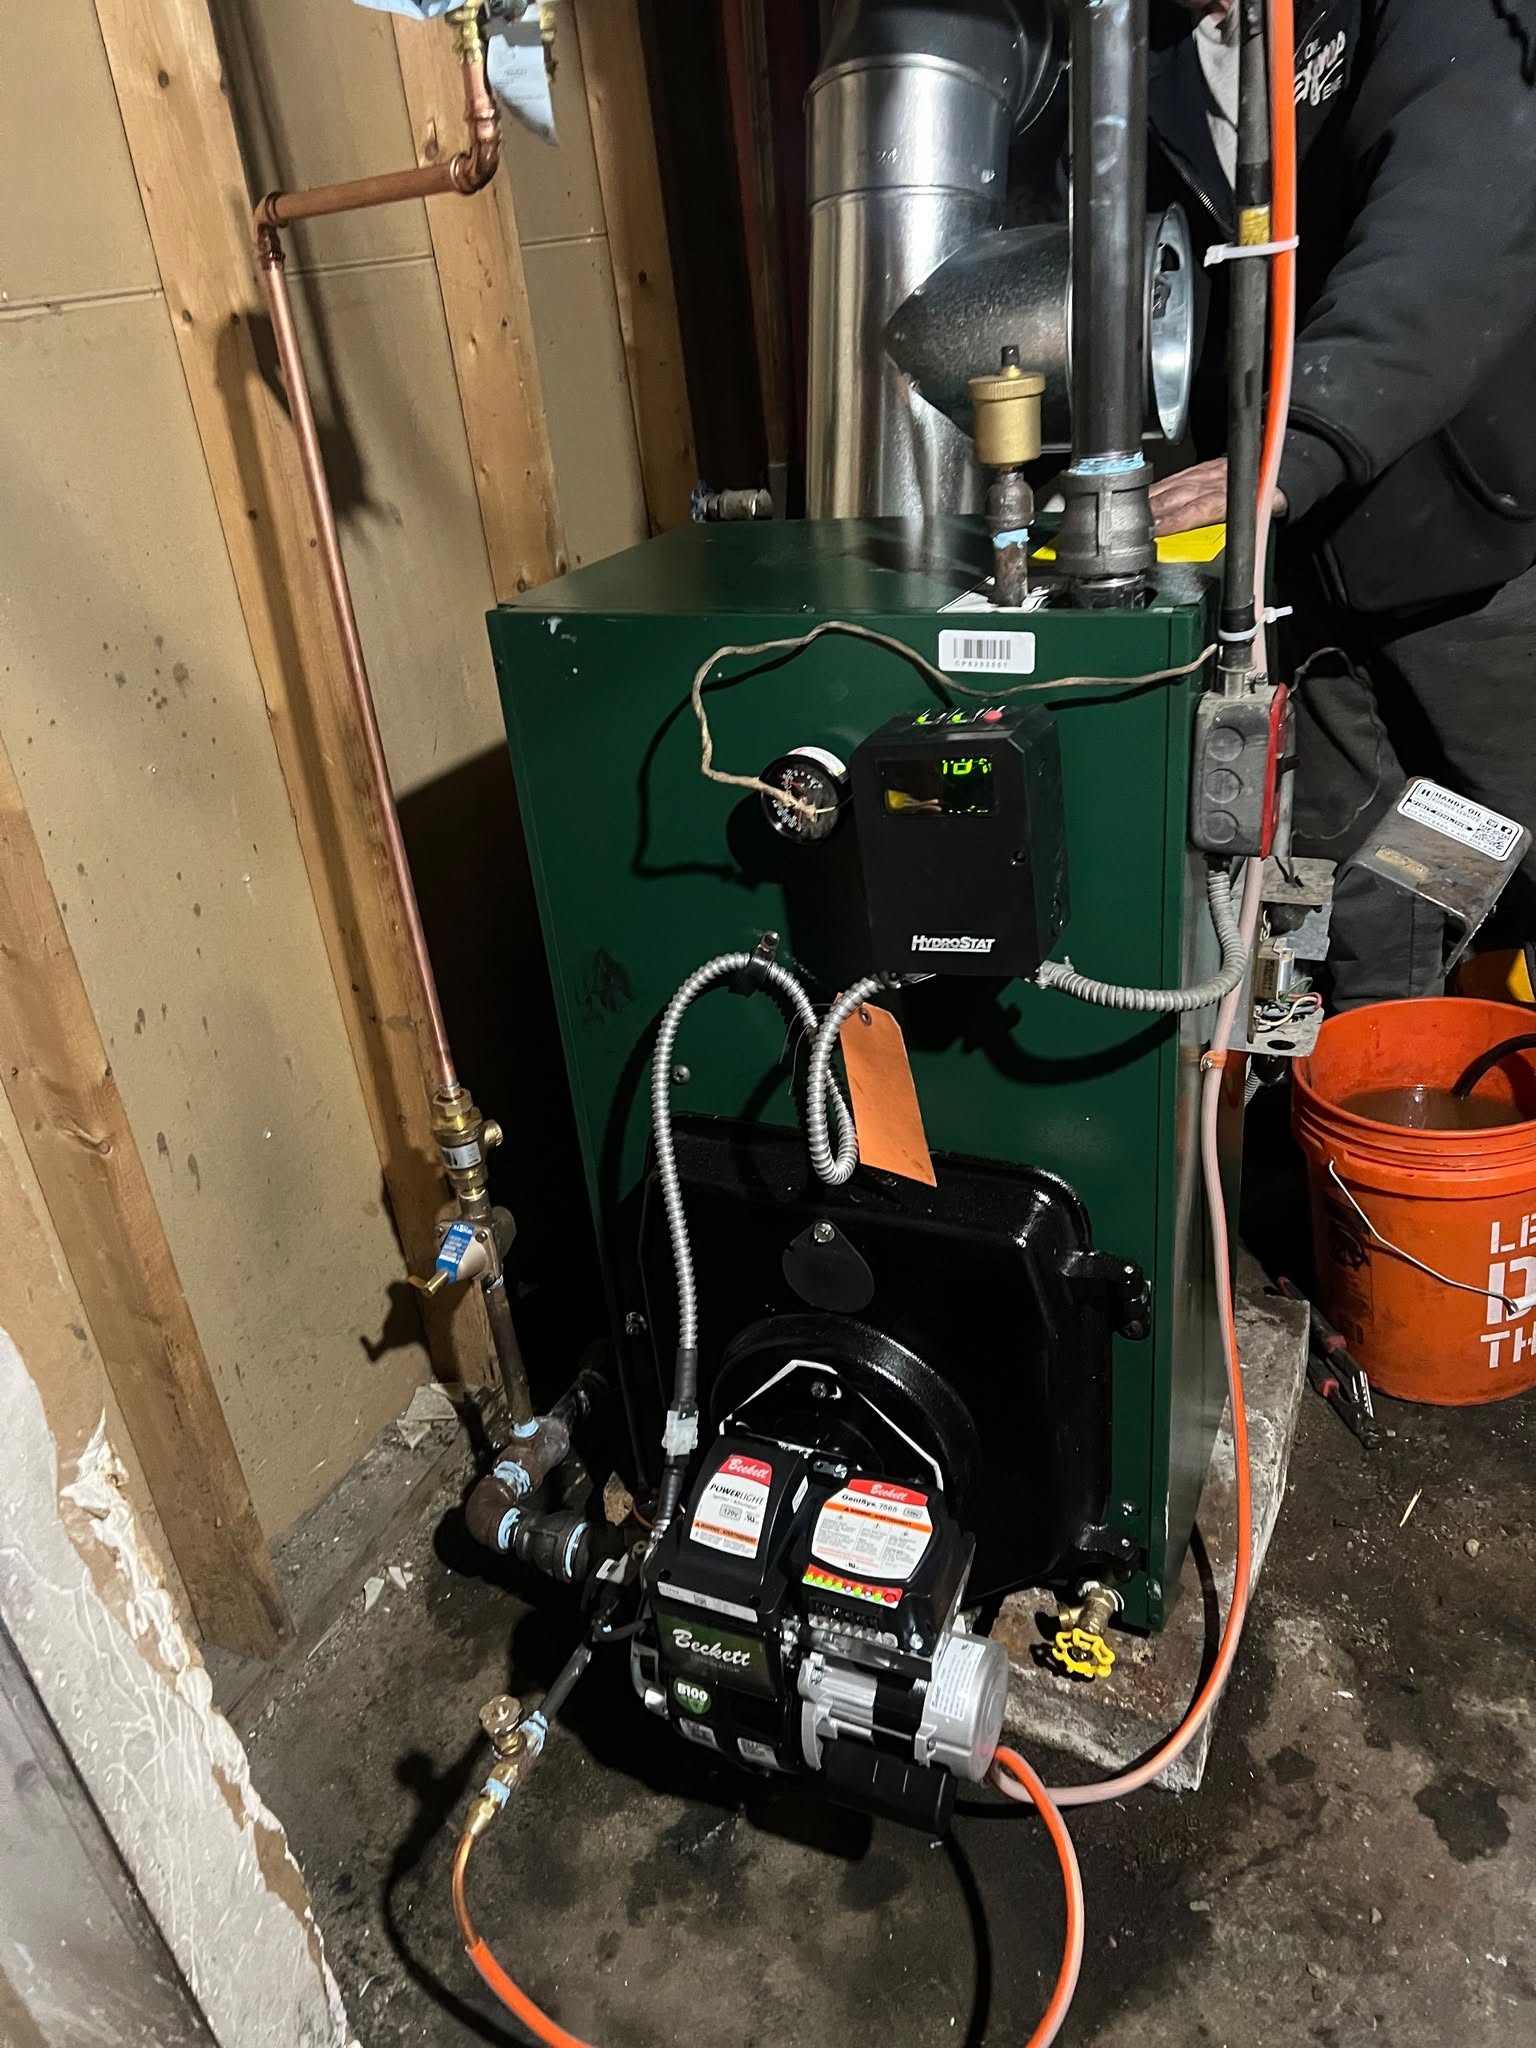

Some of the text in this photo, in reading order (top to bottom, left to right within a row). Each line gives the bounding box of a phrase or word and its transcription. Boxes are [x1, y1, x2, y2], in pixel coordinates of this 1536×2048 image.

[1434, 792, 1466, 810] HANDY
[1467, 807, 1482, 817] OIL
[727, 1458, 770, 1479] Beckett
[870, 1484, 908, 1501] Beckett
[672, 1628, 751, 1666] Beckett
[677, 1682, 708, 1702] B100
